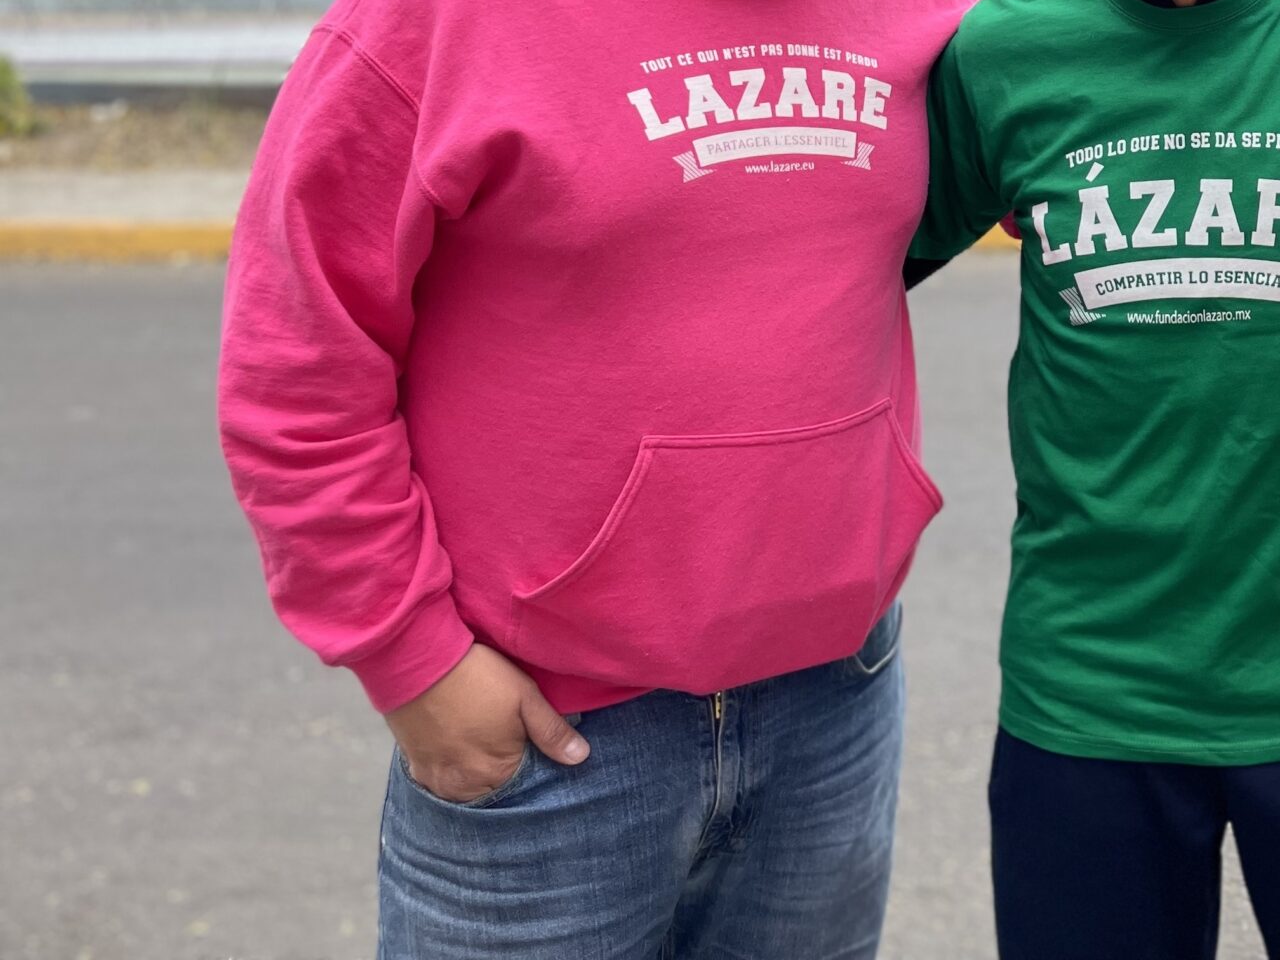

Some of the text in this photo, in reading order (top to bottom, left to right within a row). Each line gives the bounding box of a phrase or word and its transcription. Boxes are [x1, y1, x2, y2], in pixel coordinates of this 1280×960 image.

[640, 43, 878, 74] TOUT CE QUI N'EST PAS DONNÉ EST PERDU
[627, 67, 892, 141] LAZARE
[706, 134, 849, 155] PARTAGER L'ESSENTIEL
[1065, 143, 1104, 169] TODO
[1107, 139, 1127, 157] LO
[1130, 134, 1160, 153] QUE
[1163, 133, 1186, 151] NO
[1190, 132, 1211, 149] SE
[1214, 132, 1238, 148] DA
[1241, 131, 1262, 148] SE
[745, 161, 815, 174] www.lazare.eu
[1095, 271, 1183, 296] COMPARTIR
[1189, 271, 1209, 284] LO
[1127, 309, 1251, 325] www.fundacionlazaro.mx
